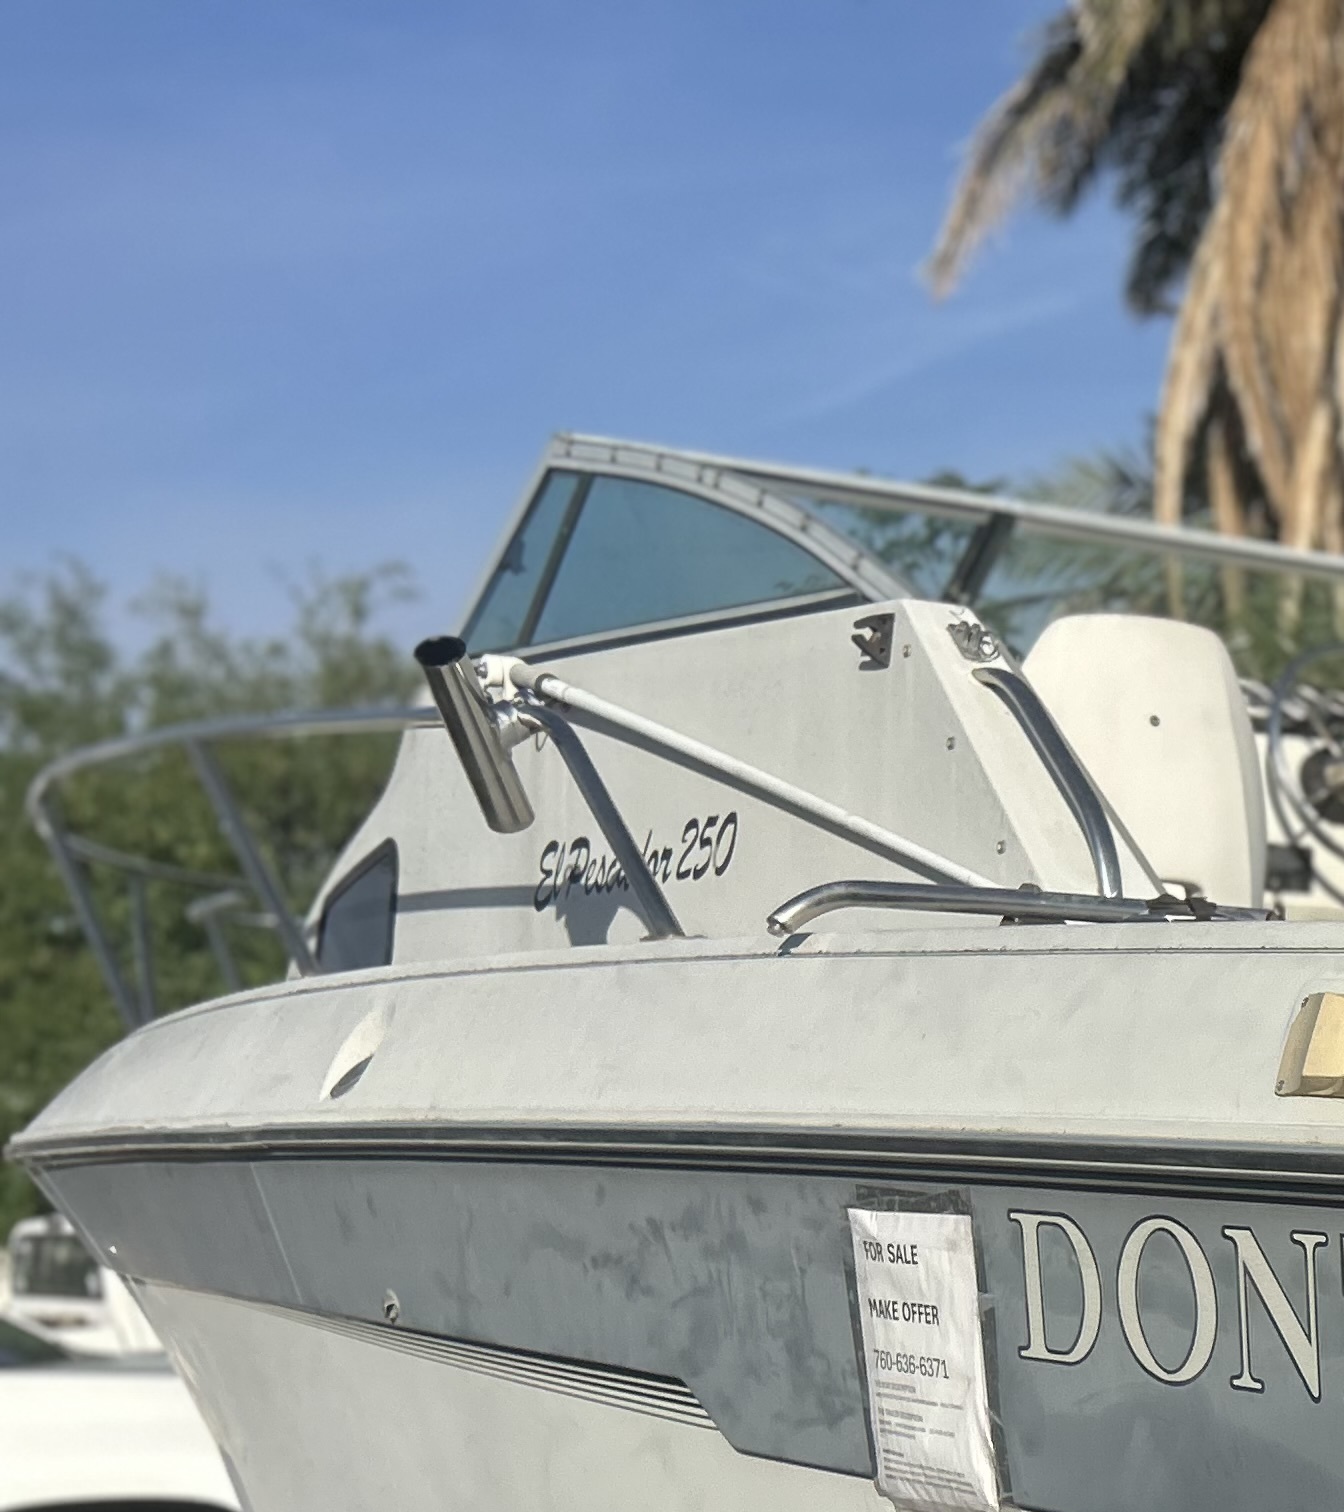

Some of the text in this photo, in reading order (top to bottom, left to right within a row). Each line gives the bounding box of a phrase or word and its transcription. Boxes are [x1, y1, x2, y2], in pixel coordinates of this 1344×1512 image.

[534, 839, 566, 912] El
[676, 812, 738, 882] 250
[863, 1240, 918, 1265] FOR SALE
[868, 1298, 939, 1326] MAKE OFFER
[873, 1349, 949, 1379] 760-636-6371
